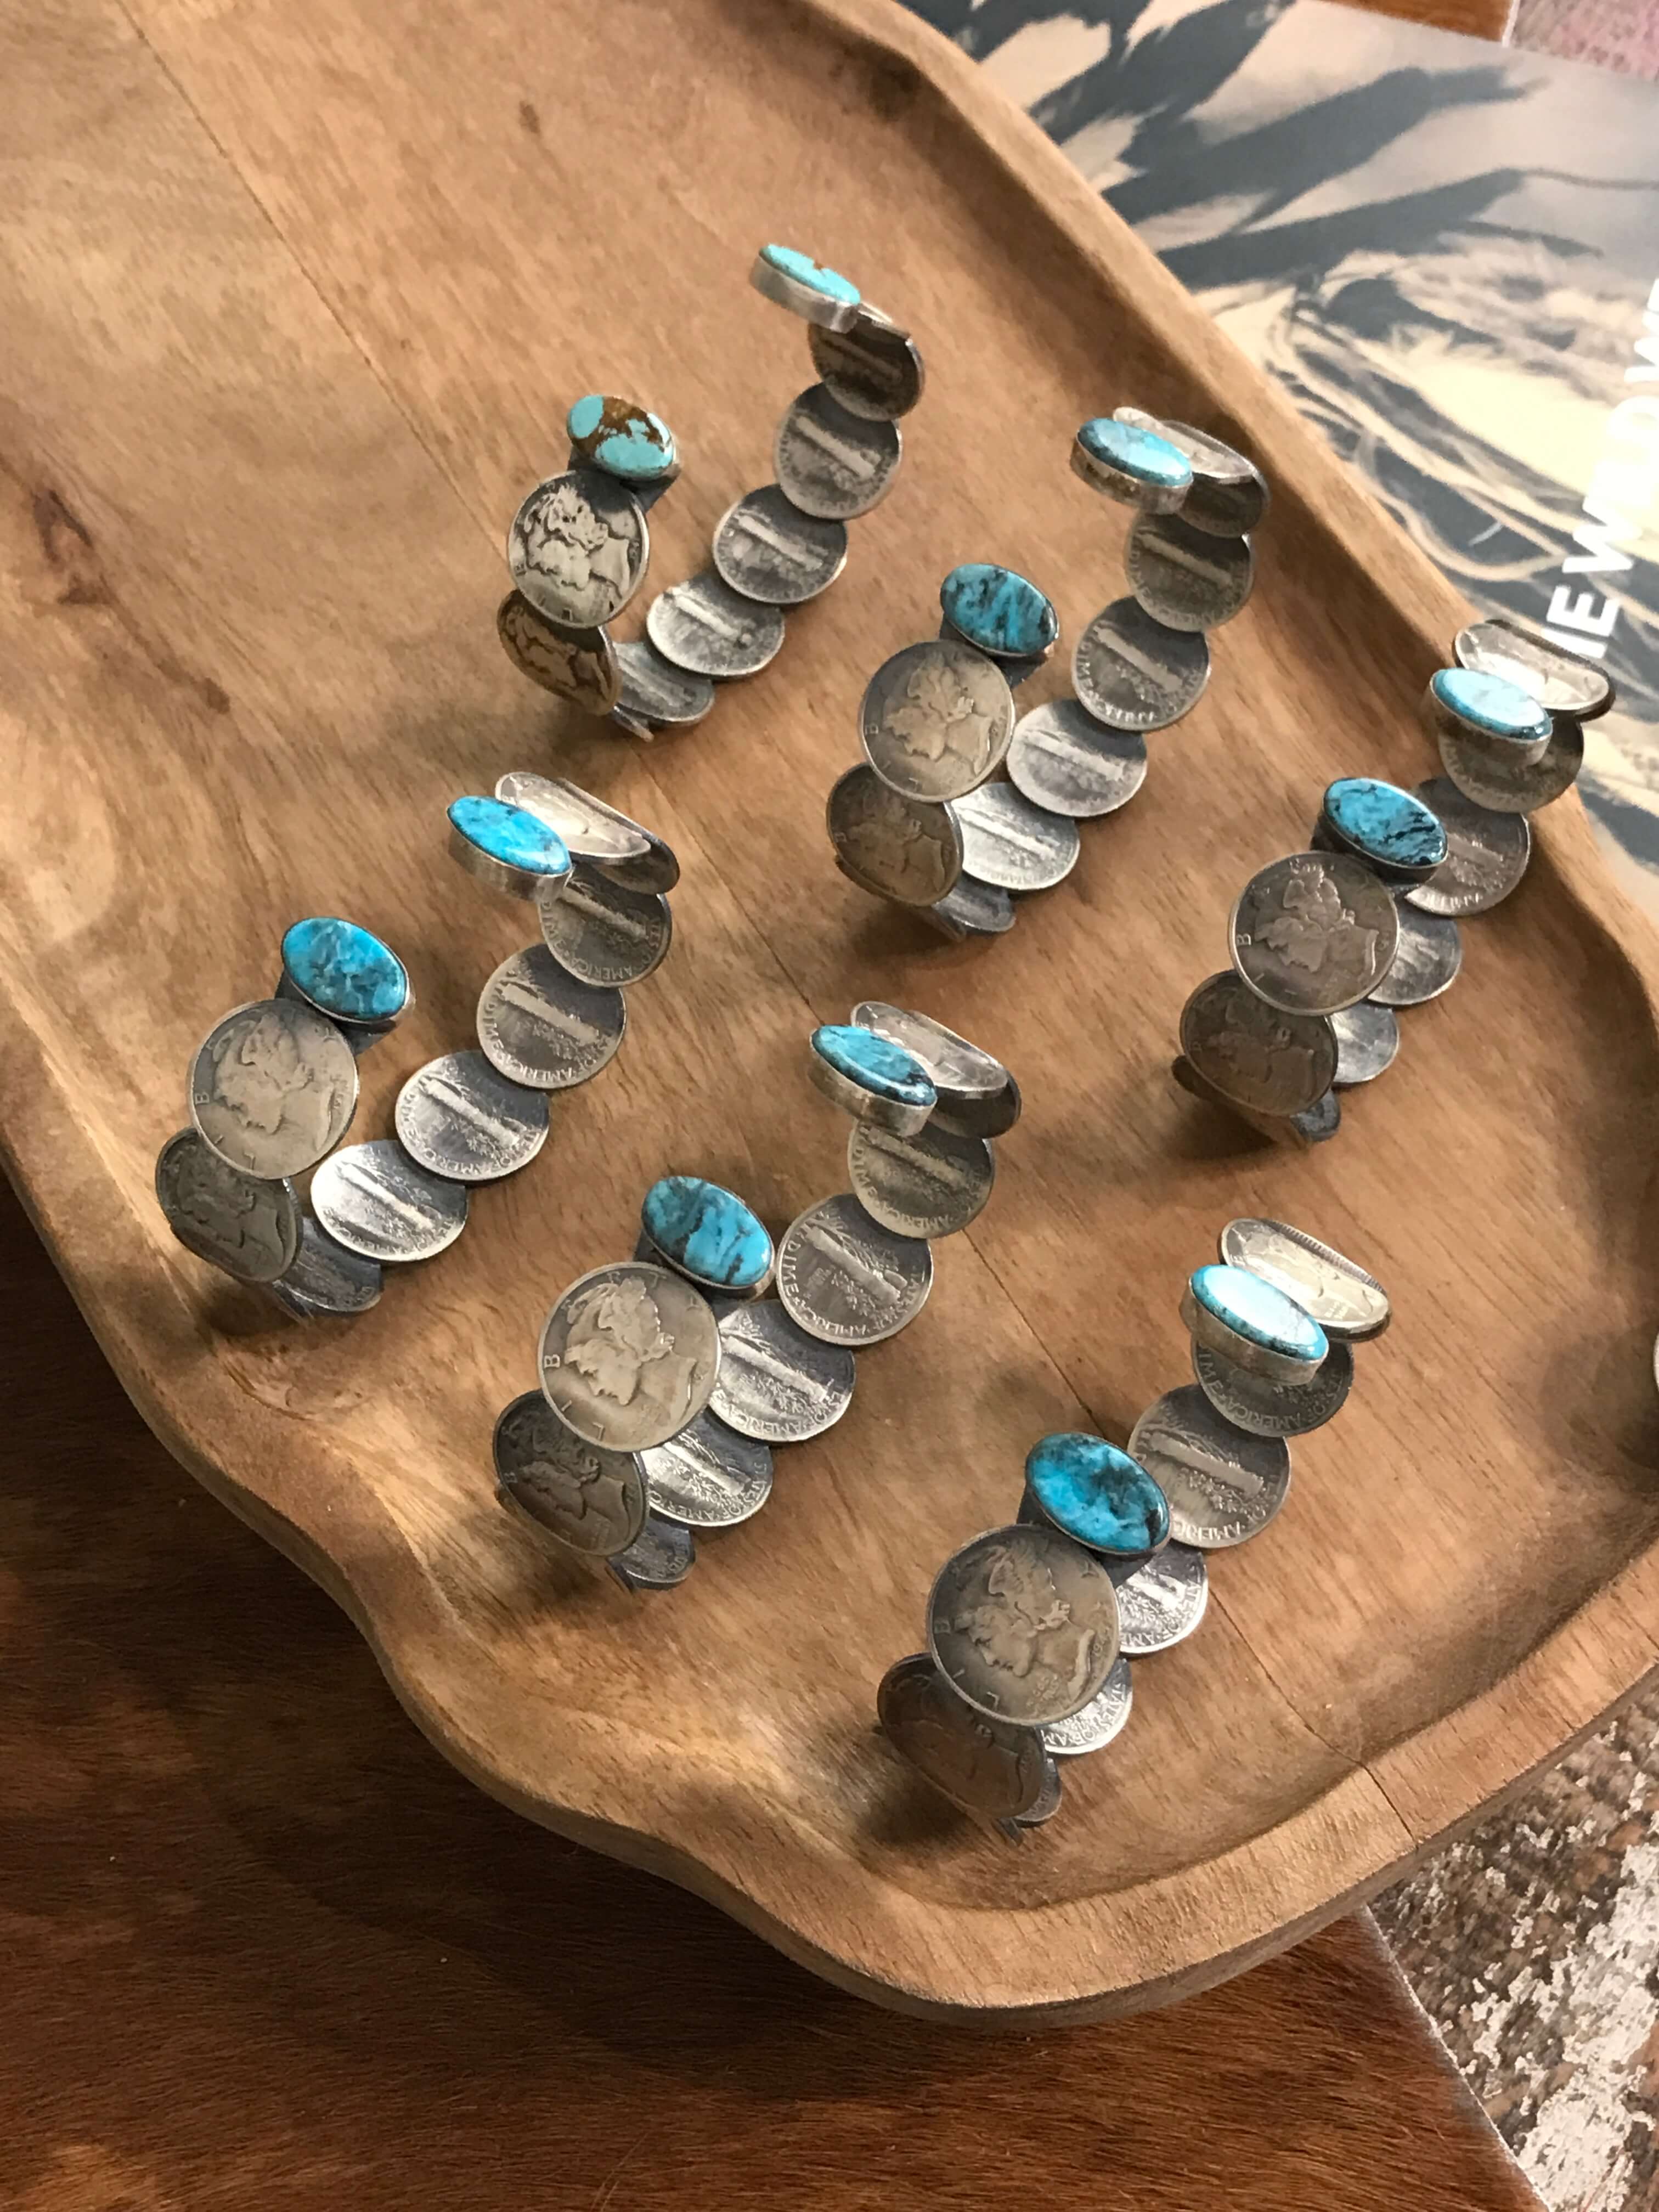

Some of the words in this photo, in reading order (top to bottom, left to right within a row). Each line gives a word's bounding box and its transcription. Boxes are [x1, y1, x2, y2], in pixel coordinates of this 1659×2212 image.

[571, 956, 633, 981] AMERICA
[782, 1241, 801, 1297] DIME
[1227, 1401, 1302, 1429] AMERICA
